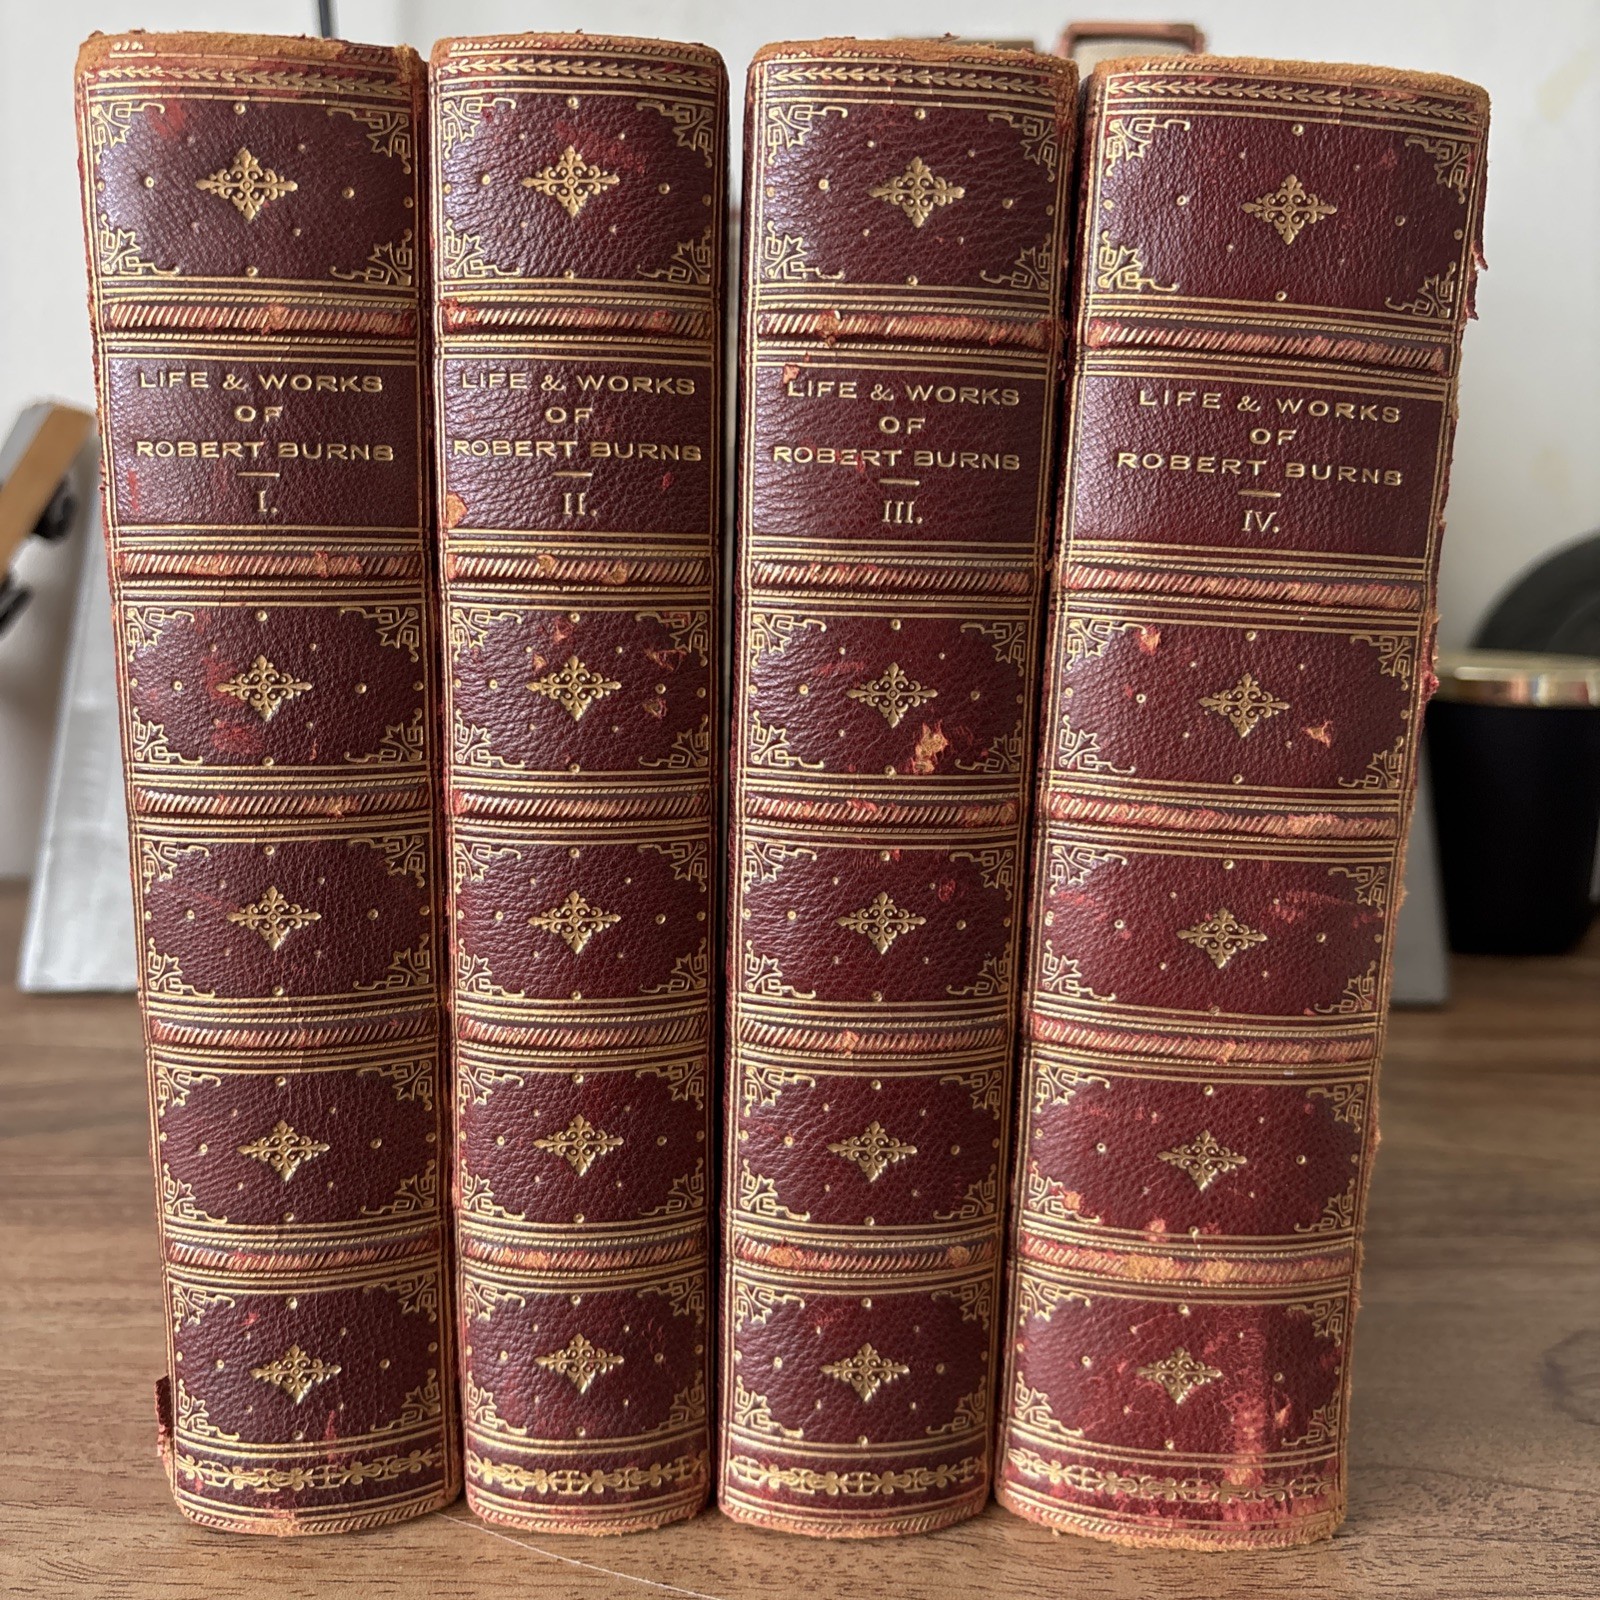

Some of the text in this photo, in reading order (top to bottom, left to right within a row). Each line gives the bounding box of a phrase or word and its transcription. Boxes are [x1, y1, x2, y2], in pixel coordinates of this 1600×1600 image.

[140, 372, 383, 393] LIFE & WORKS
[462, 373, 696, 395] LIFE & WORKS
[788, 380, 1020, 406] LIFE & WORKS
[234, 405, 283, 422] OF
[545, 406, 594, 424] OF
[1139, 389, 1401, 423] LIFE & WORKS
[879, 416, 926, 434] OF
[1250, 428, 1297, 446] OF
[136, 441, 394, 462] ROBERT BURNS
[453, 440, 702, 462] ROBERT BURNS
[774, 446, 1020, 470] ROBERT BURNS
[1116, 452, 1403, 486] ROBERT BURNS
[256, 490, 278, 514] I.
[563, 492, 598, 516] II.
[882, 500, 923, 524] III.
[1241, 510, 1279, 533] IV.
